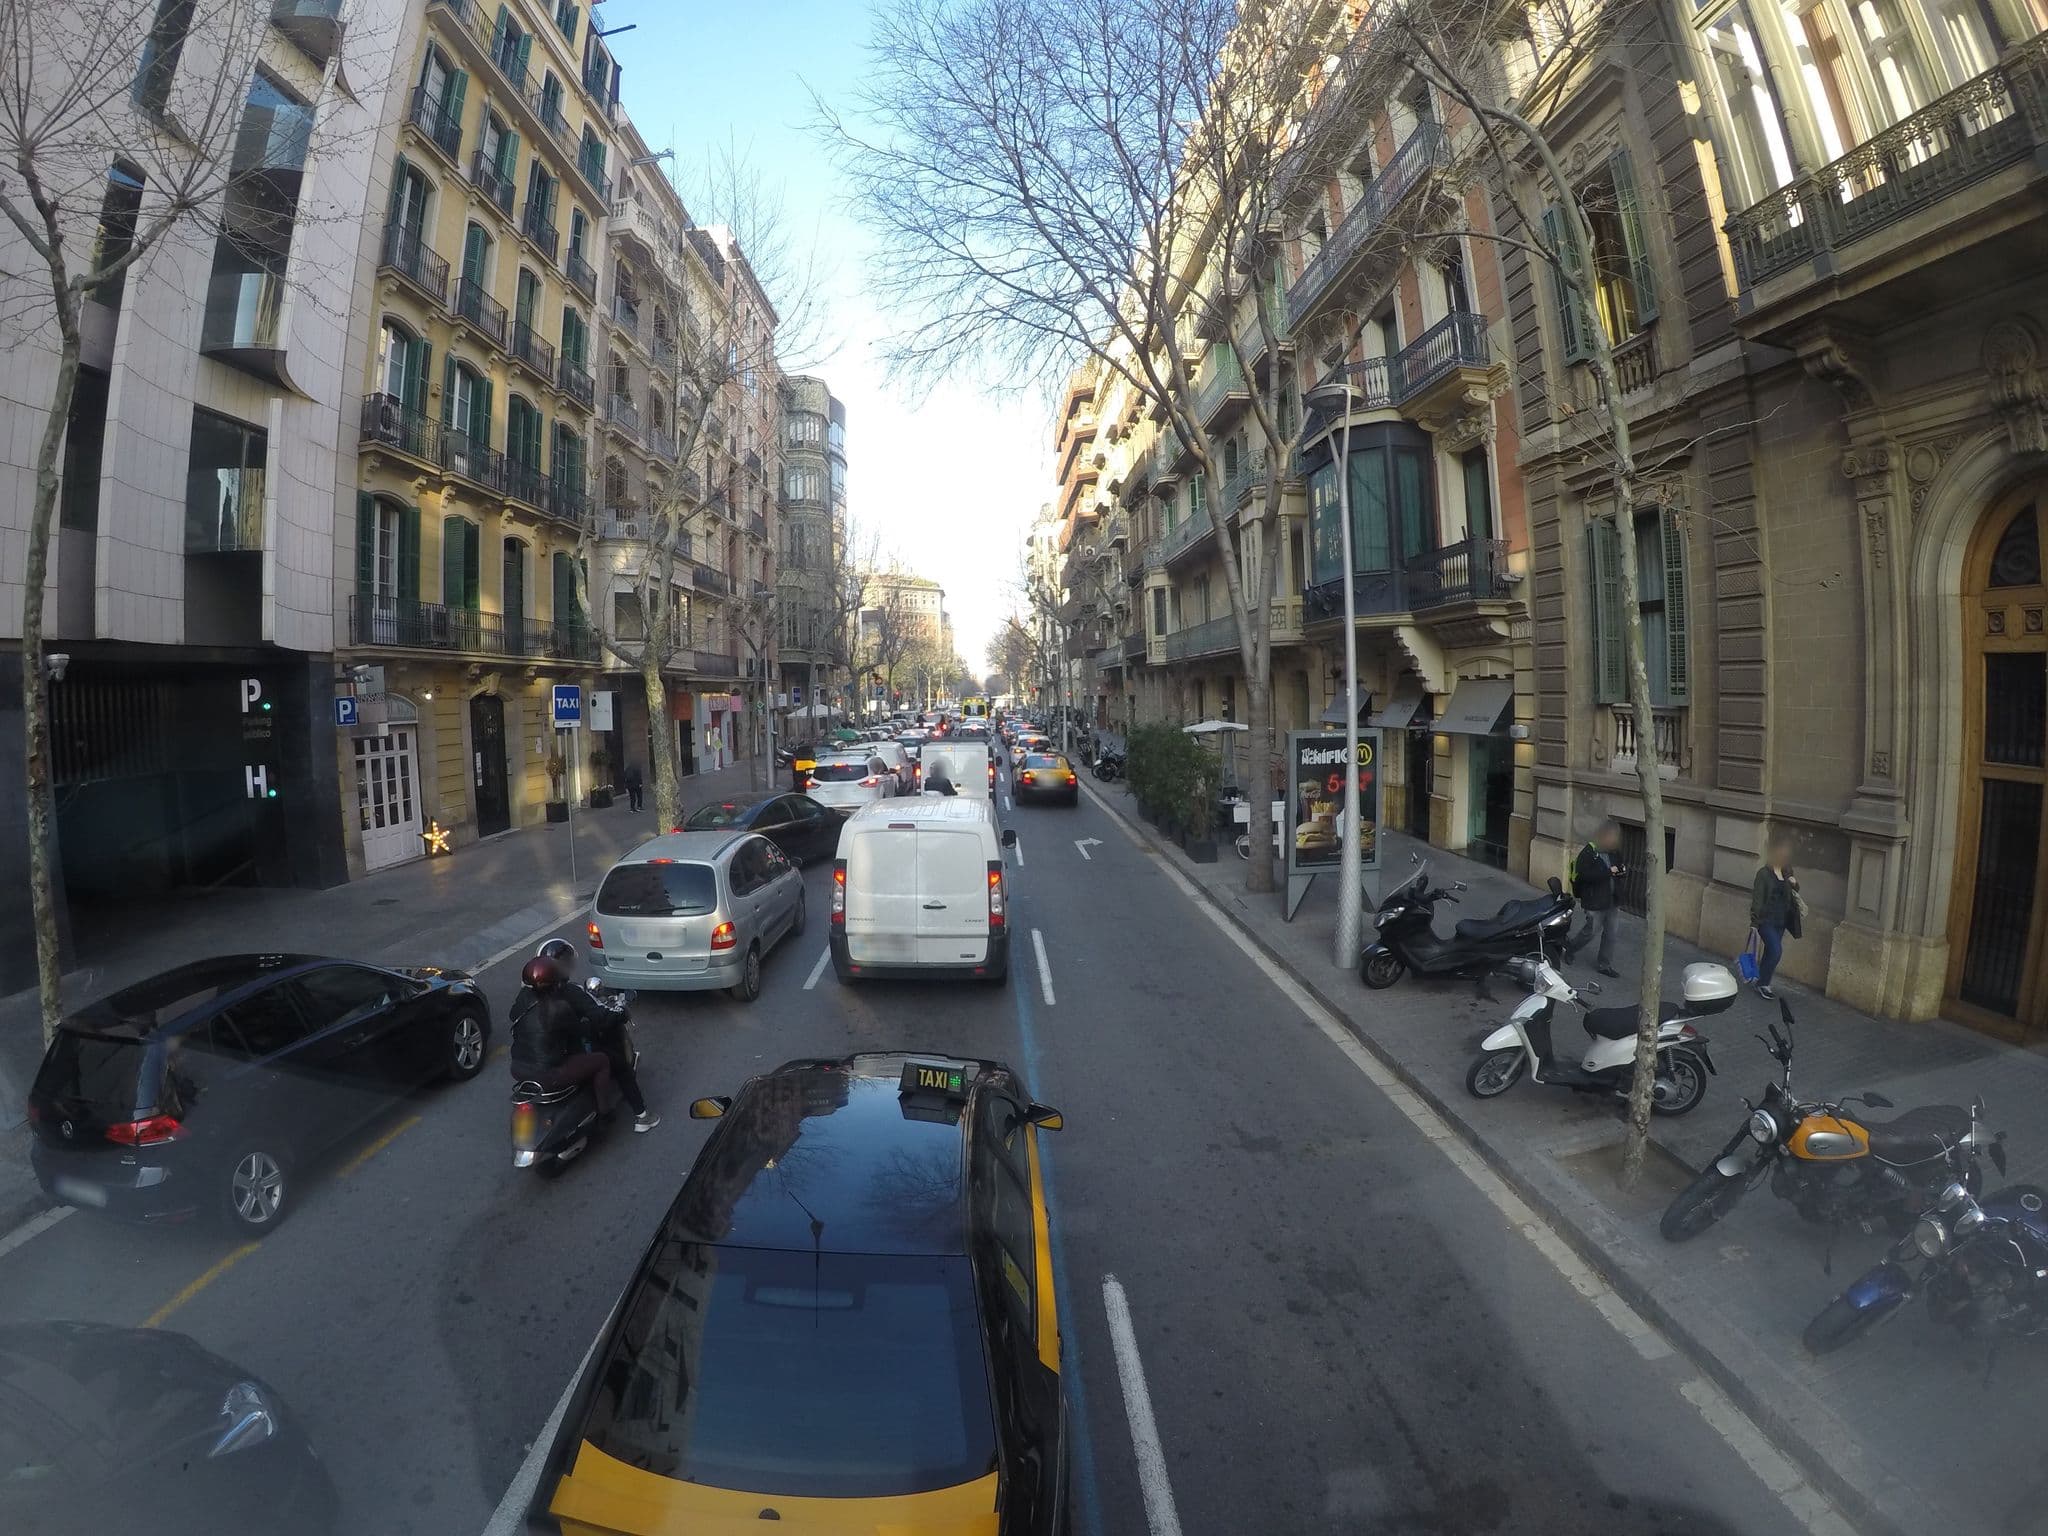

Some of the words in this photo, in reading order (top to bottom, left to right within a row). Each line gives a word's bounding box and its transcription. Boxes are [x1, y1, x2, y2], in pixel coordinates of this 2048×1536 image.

[241, 678, 262, 713] P
[556, 697, 579, 709] TAXI
[339, 700, 352, 722] P
[245, 764, 267, 798] H
[918, 1068, 948, 1089] TAXI
